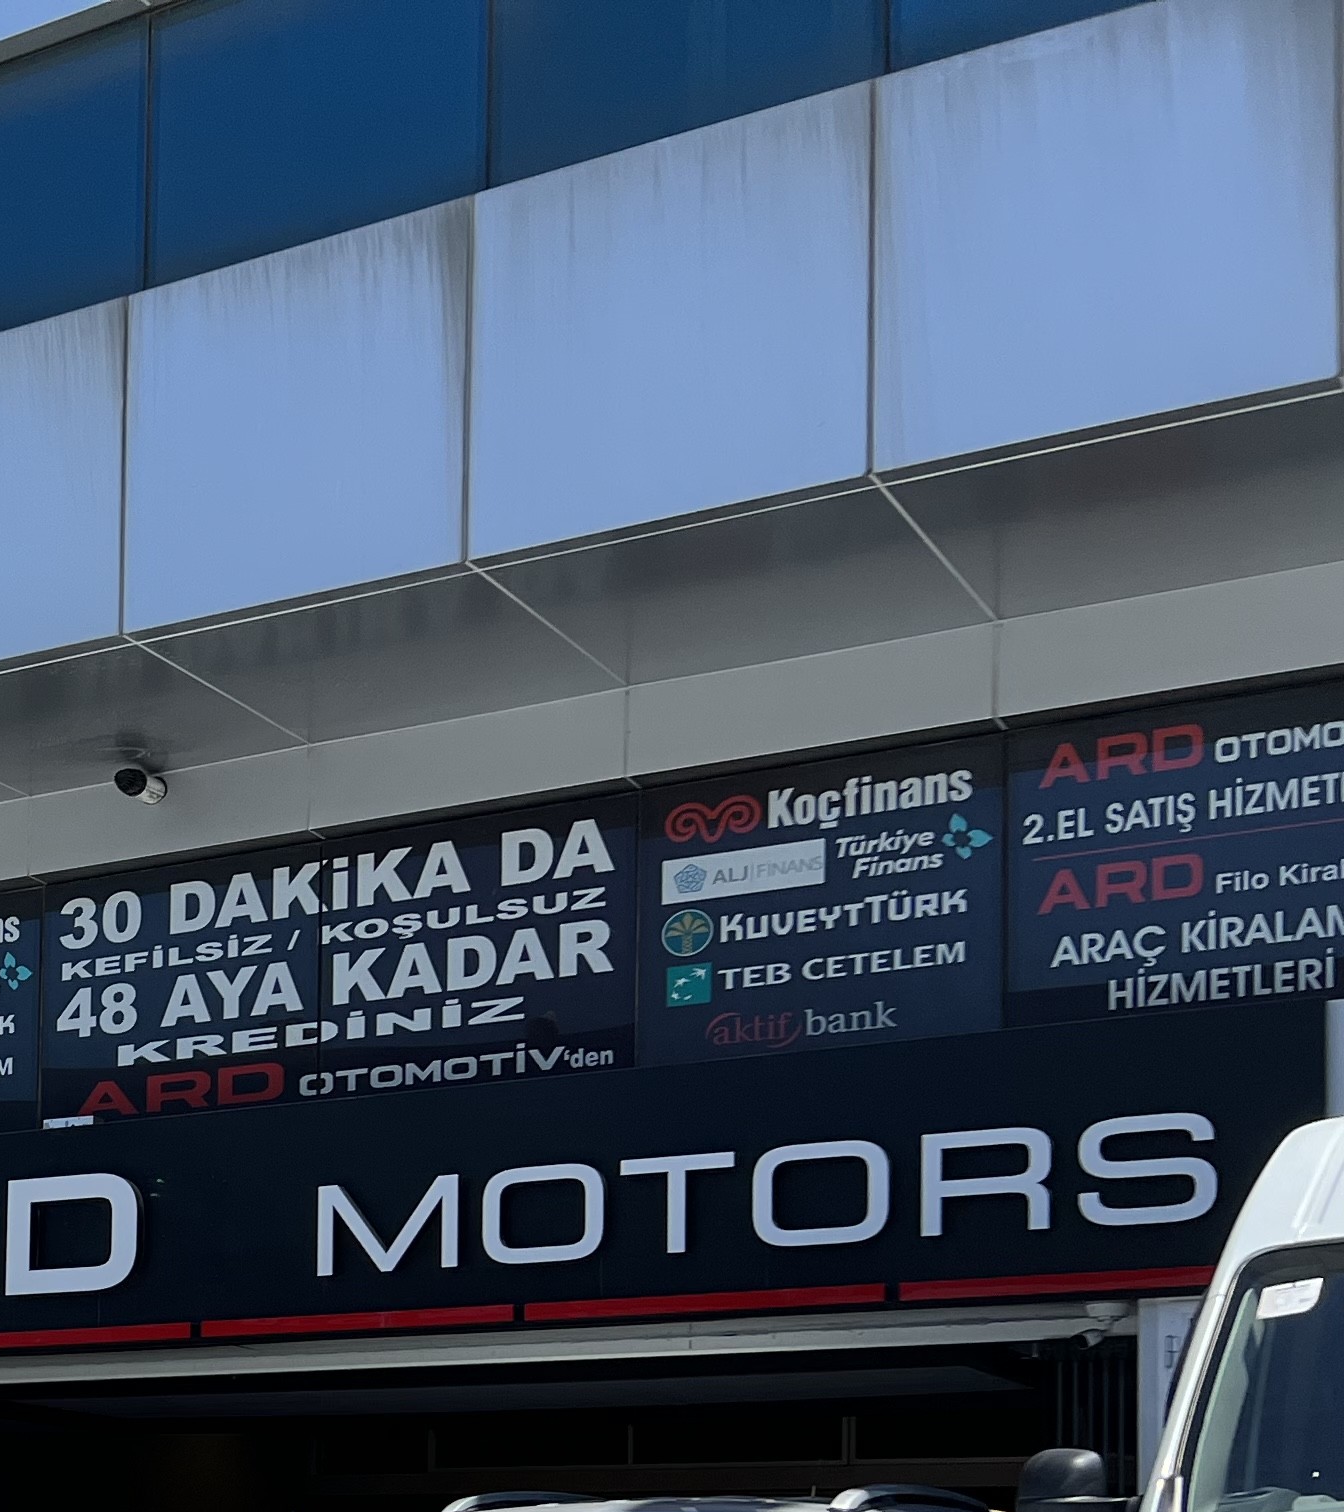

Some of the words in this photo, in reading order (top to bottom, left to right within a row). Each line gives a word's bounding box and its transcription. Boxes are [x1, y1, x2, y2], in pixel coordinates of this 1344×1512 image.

[1038, 724, 1205, 790] ARD
[767, 770, 972, 830] Koçfinans
[1022, 808, 1094, 845] 2.EL
[1105, 793, 1196, 832] SATIŞ
[1208, 772, 1344, 820] HİZMET
[835, 830, 935, 858] Türkiye
[852, 853, 944, 879] Finans
[60, 890, 142, 950] 30
[501, 818, 615, 886] DA
[1037, 854, 1204, 916] ARD
[1216, 871, 1269, 894] Filo
[322, 886, 606, 944] KOŞULSUZ
[718, 963, 791, 990] TEB
[801, 941, 966, 980] CETELEM
[1050, 926, 1166, 967] ARAÇ
[57, 982, 138, 1038] 48
[160, 961, 304, 1027] AYA
[332, 920, 614, 1006] KADAR
[1108, 948, 1334, 1010] HİZMETLERİ
[118, 996, 524, 1066] KREDİNİZ
[713, 1012, 793, 1046] aktif
[804, 1002, 898, 1036] bank
[78, 1062, 284, 1116] ARD
[316, 1110, 1219, 1277] MOTORS
